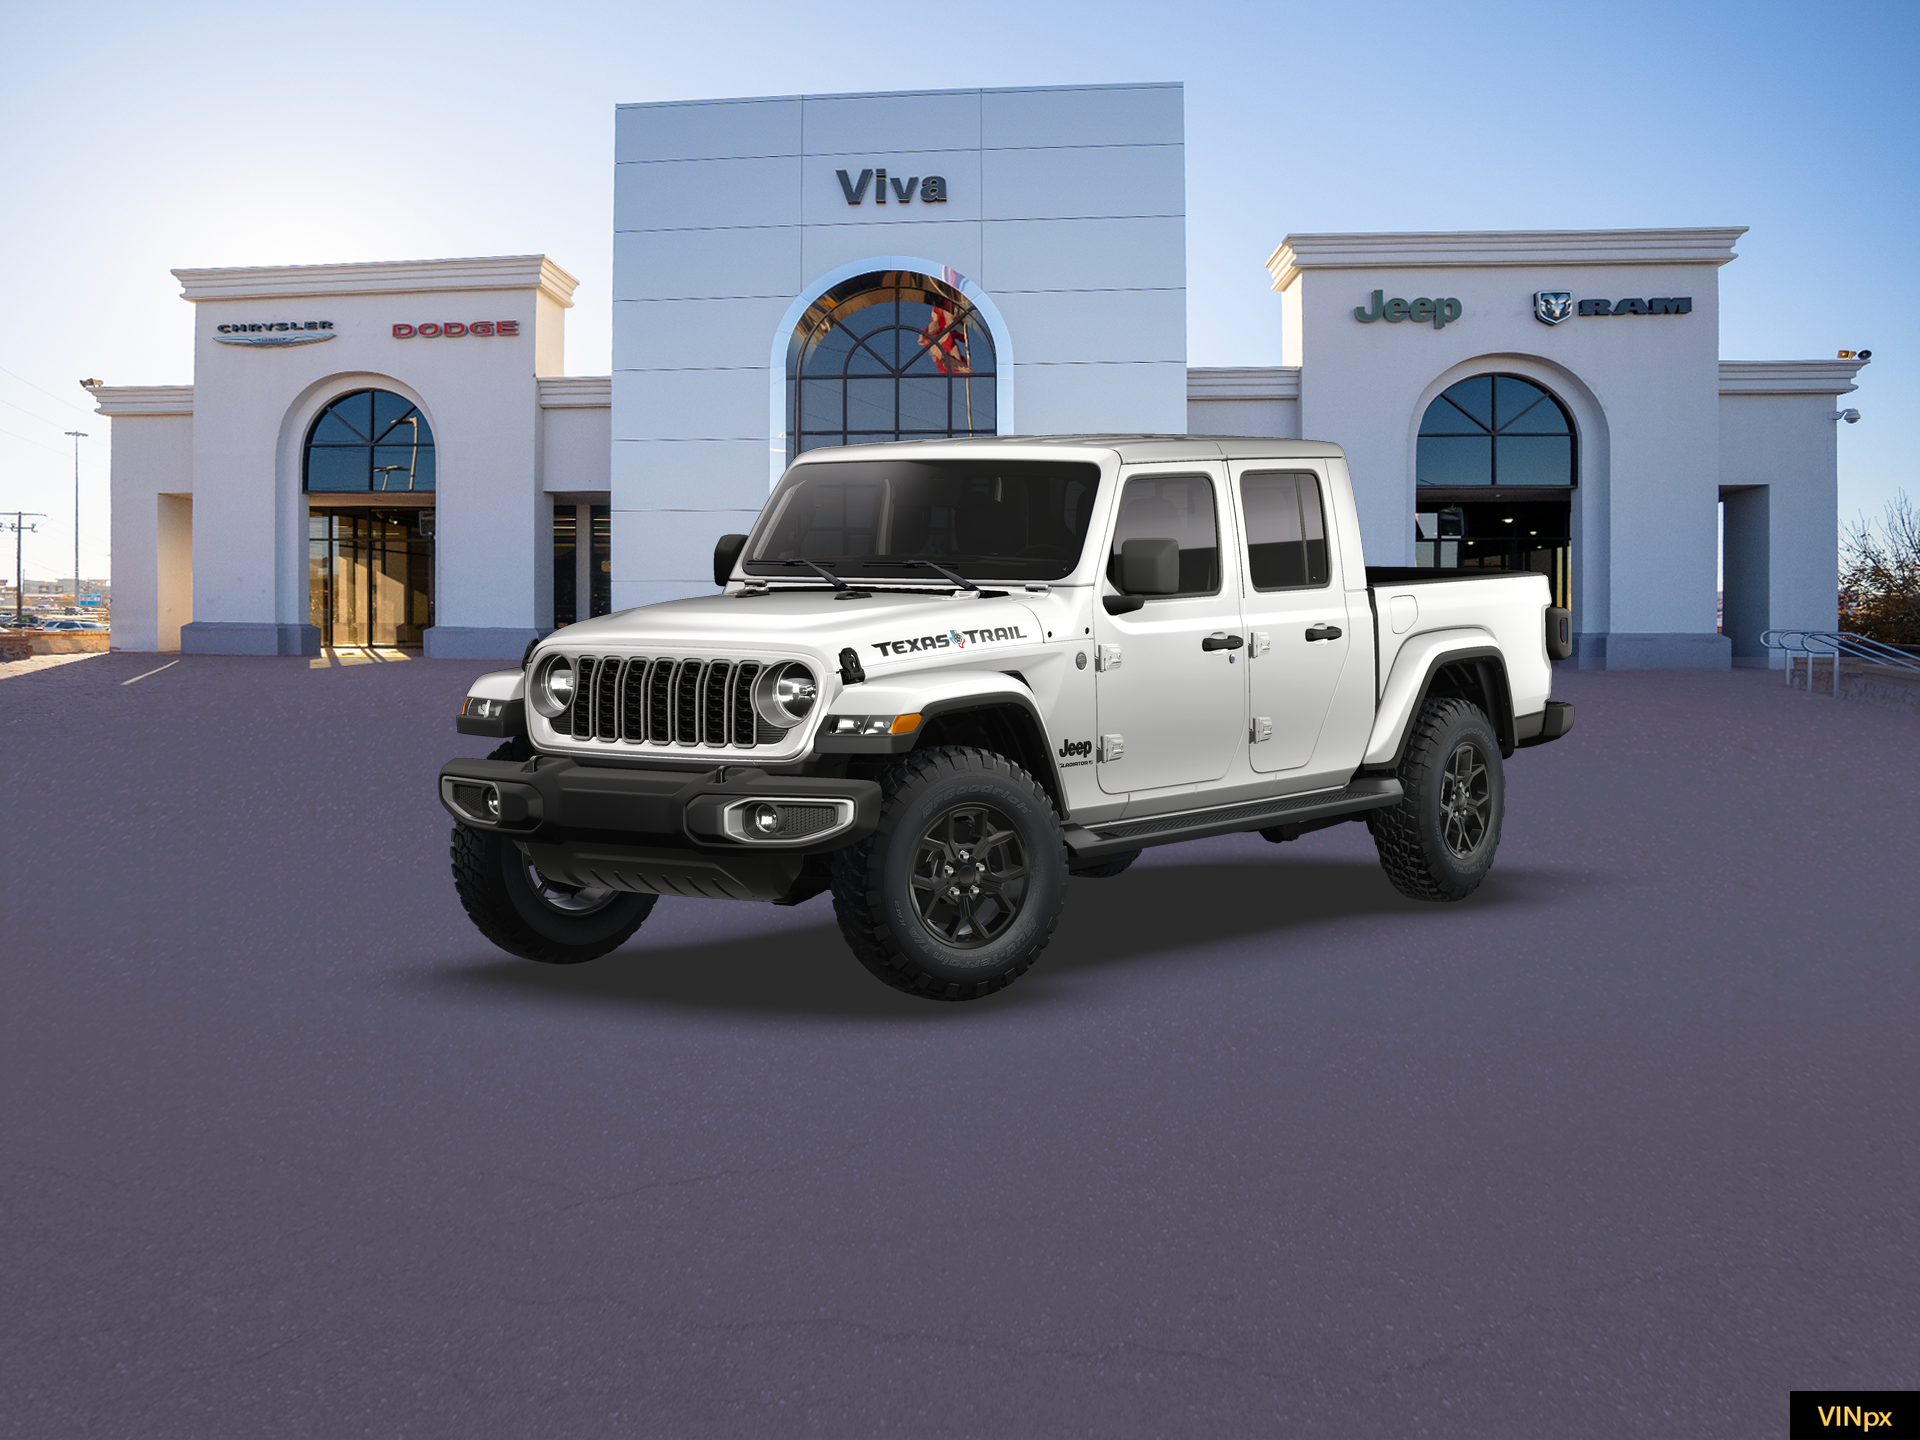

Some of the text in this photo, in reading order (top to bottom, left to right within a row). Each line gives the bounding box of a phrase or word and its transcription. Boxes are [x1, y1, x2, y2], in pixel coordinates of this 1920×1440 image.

[835, 168, 947, 205] Viva
[1354, 289, 1462, 329] Jeep
[1579, 297, 1692, 316] RAM
[217, 321, 334, 333] CHRYSLER
[392, 319, 520, 339] DODGE
[871, 626, 1027, 657] TEXAS TRAIL
[1059, 739, 1092, 758] Jeep
